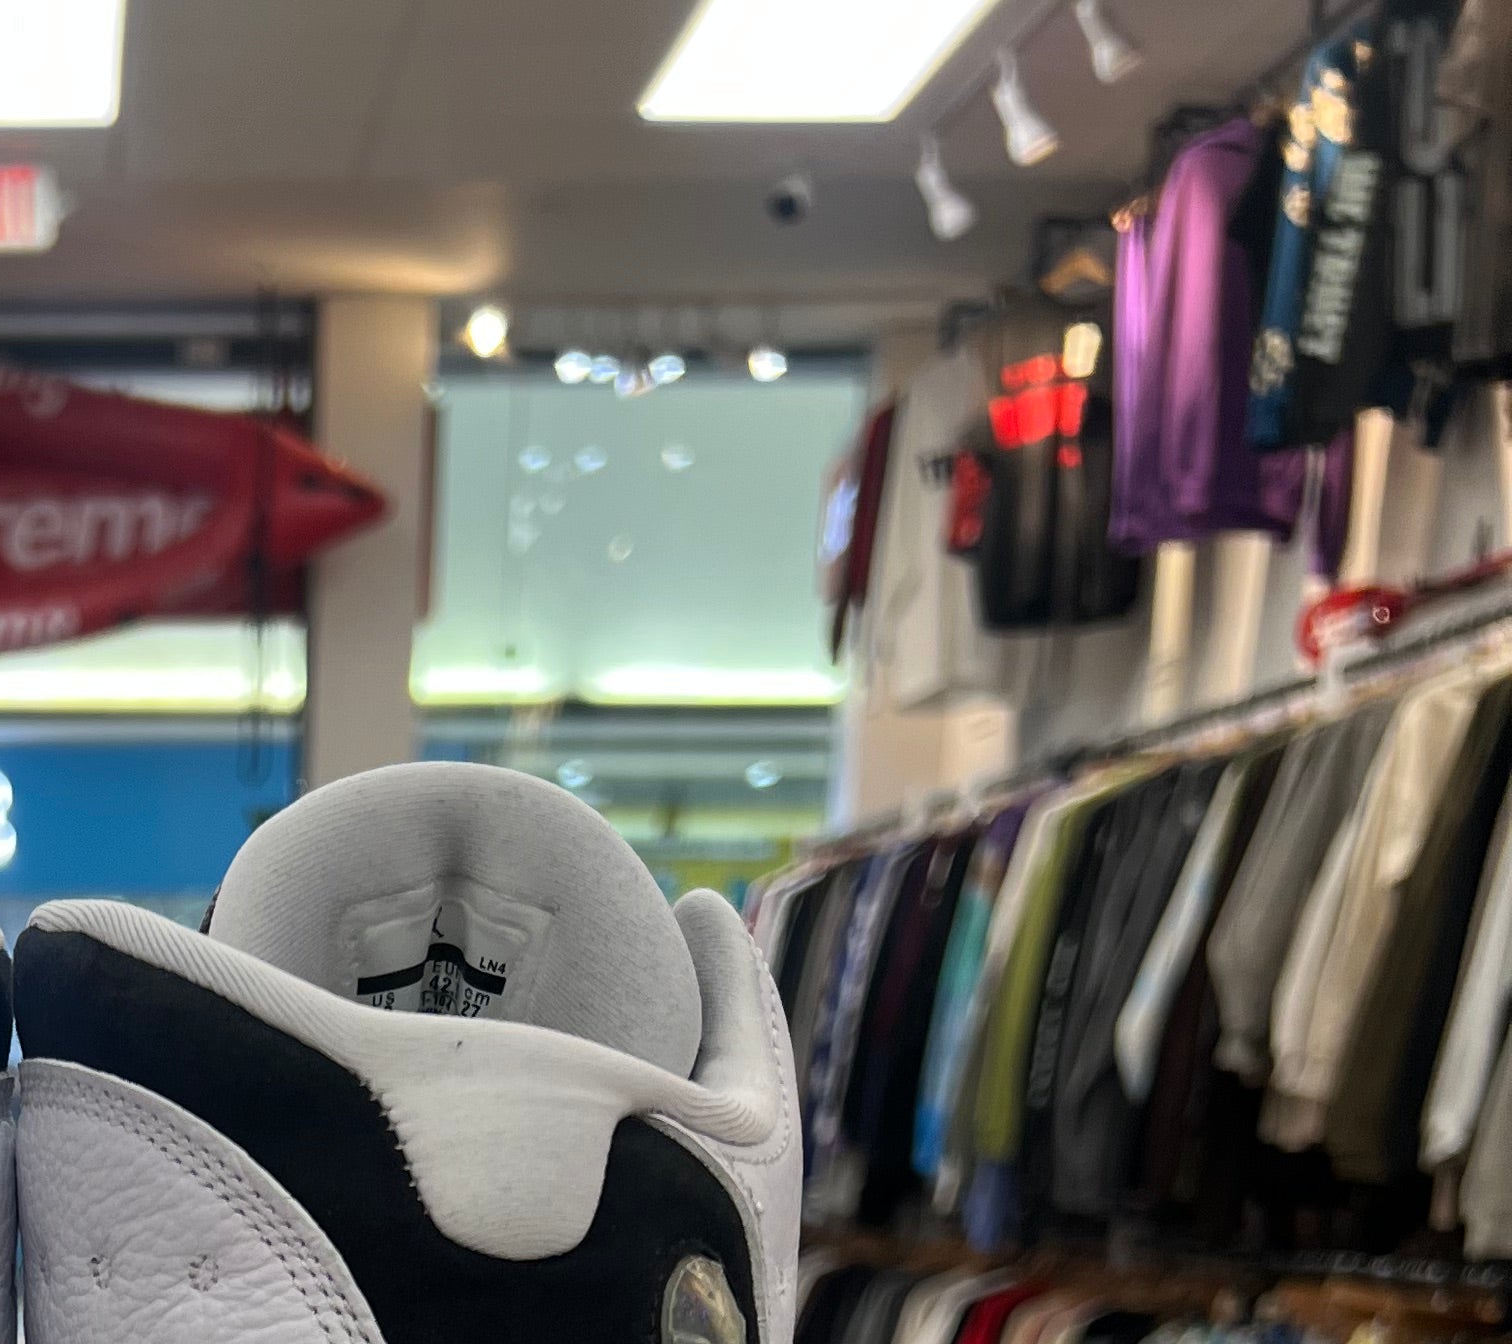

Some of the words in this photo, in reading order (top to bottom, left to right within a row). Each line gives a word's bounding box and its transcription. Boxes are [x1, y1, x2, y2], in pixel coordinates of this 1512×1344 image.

[479, 956, 507, 975] LN4
[372, 991, 395, 1008] US
[464, 987, 491, 1007] cm
[460, 1000, 481, 1018] 27
